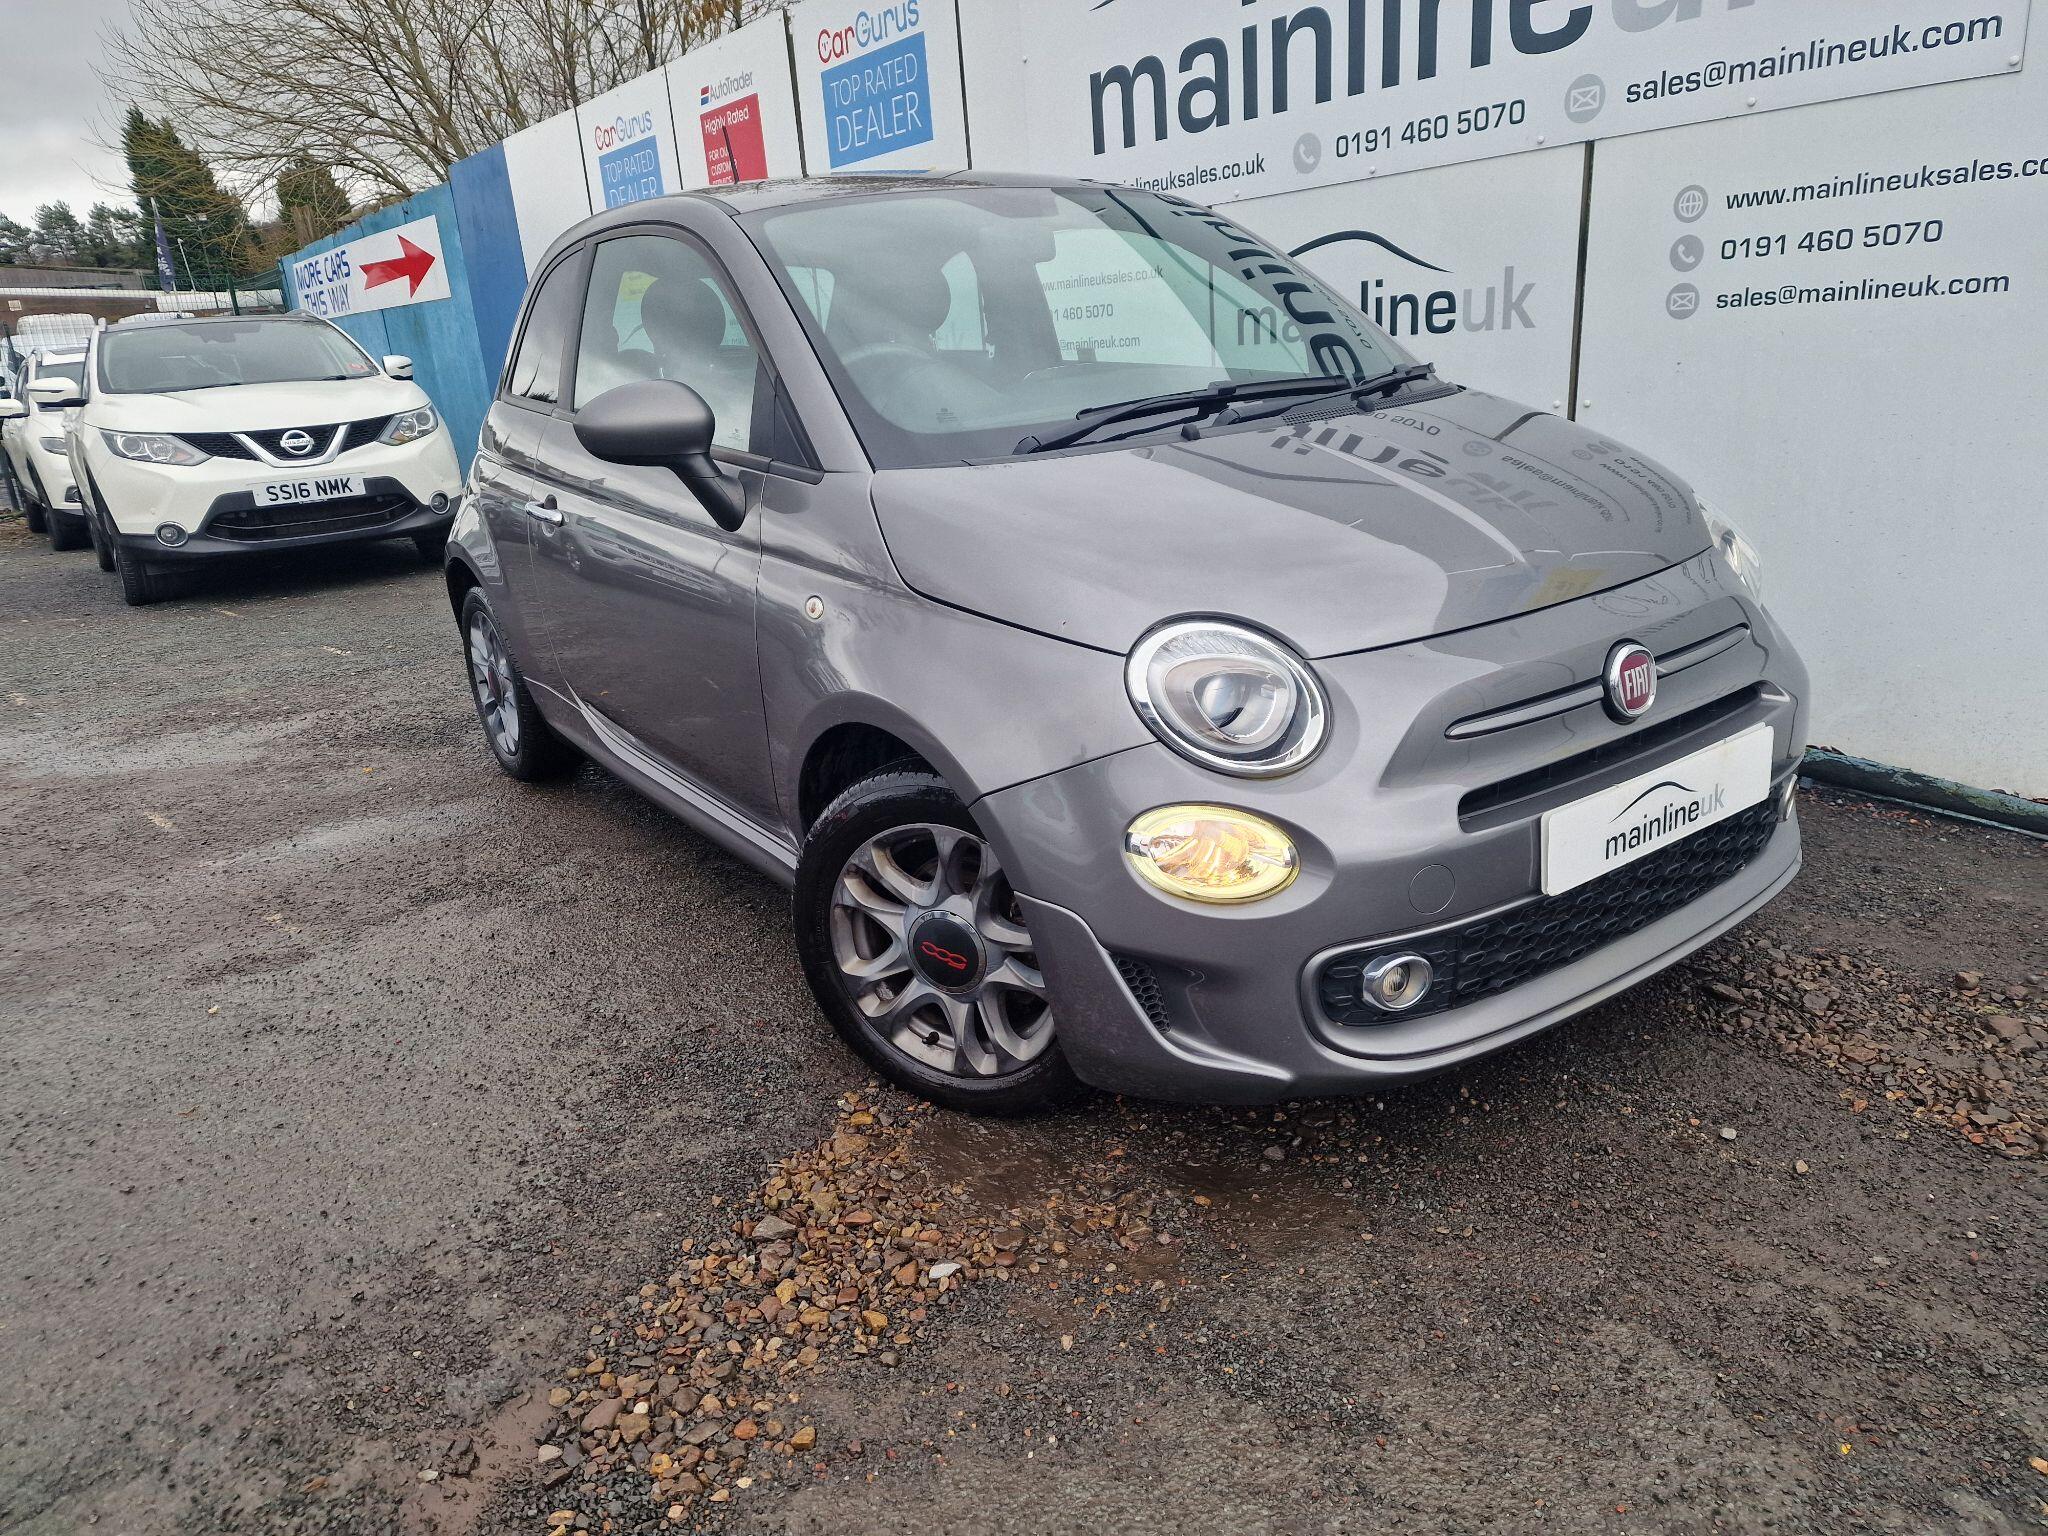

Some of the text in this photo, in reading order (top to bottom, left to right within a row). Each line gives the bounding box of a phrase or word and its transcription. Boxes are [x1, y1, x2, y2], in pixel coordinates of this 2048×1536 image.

[817, 0, 920, 64] CarGurus
[1090, 0, 1755, 156] mainline
[1626, 15, 2003, 103] sales@mainlineuk.com
[709, 71, 753, 102] AutoTrader
[830, 53, 918, 108] TOP RATED
[594, 110, 653, 151] CarGurus
[704, 104, 749, 135] Highly Rated
[836, 91, 922, 152] DEALER
[1336, 99, 1526, 159] 0191 460 5070
[604, 149, 655, 183] TOP RATED
[719, 146, 730, 158] OU
[1124, 152, 1265, 192] lineuksales.co.uk
[609, 176, 658, 207] DEALER
[1720, 219, 1944, 261] 0191 460 5070
[295, 249, 351, 291] MORE CARS
[304, 283, 351, 316] THIS WAY
[1716, 273, 2010, 309] sales@mainlineuk.com
[1063, 307, 1083, 321] 460
[1086, 304, 1114, 319] 5070
[265, 478, 353, 502] SS16 NMK
[1623, 662, 1650, 701] FIAT
[1604, 783, 1726, 860] mainlineuk
